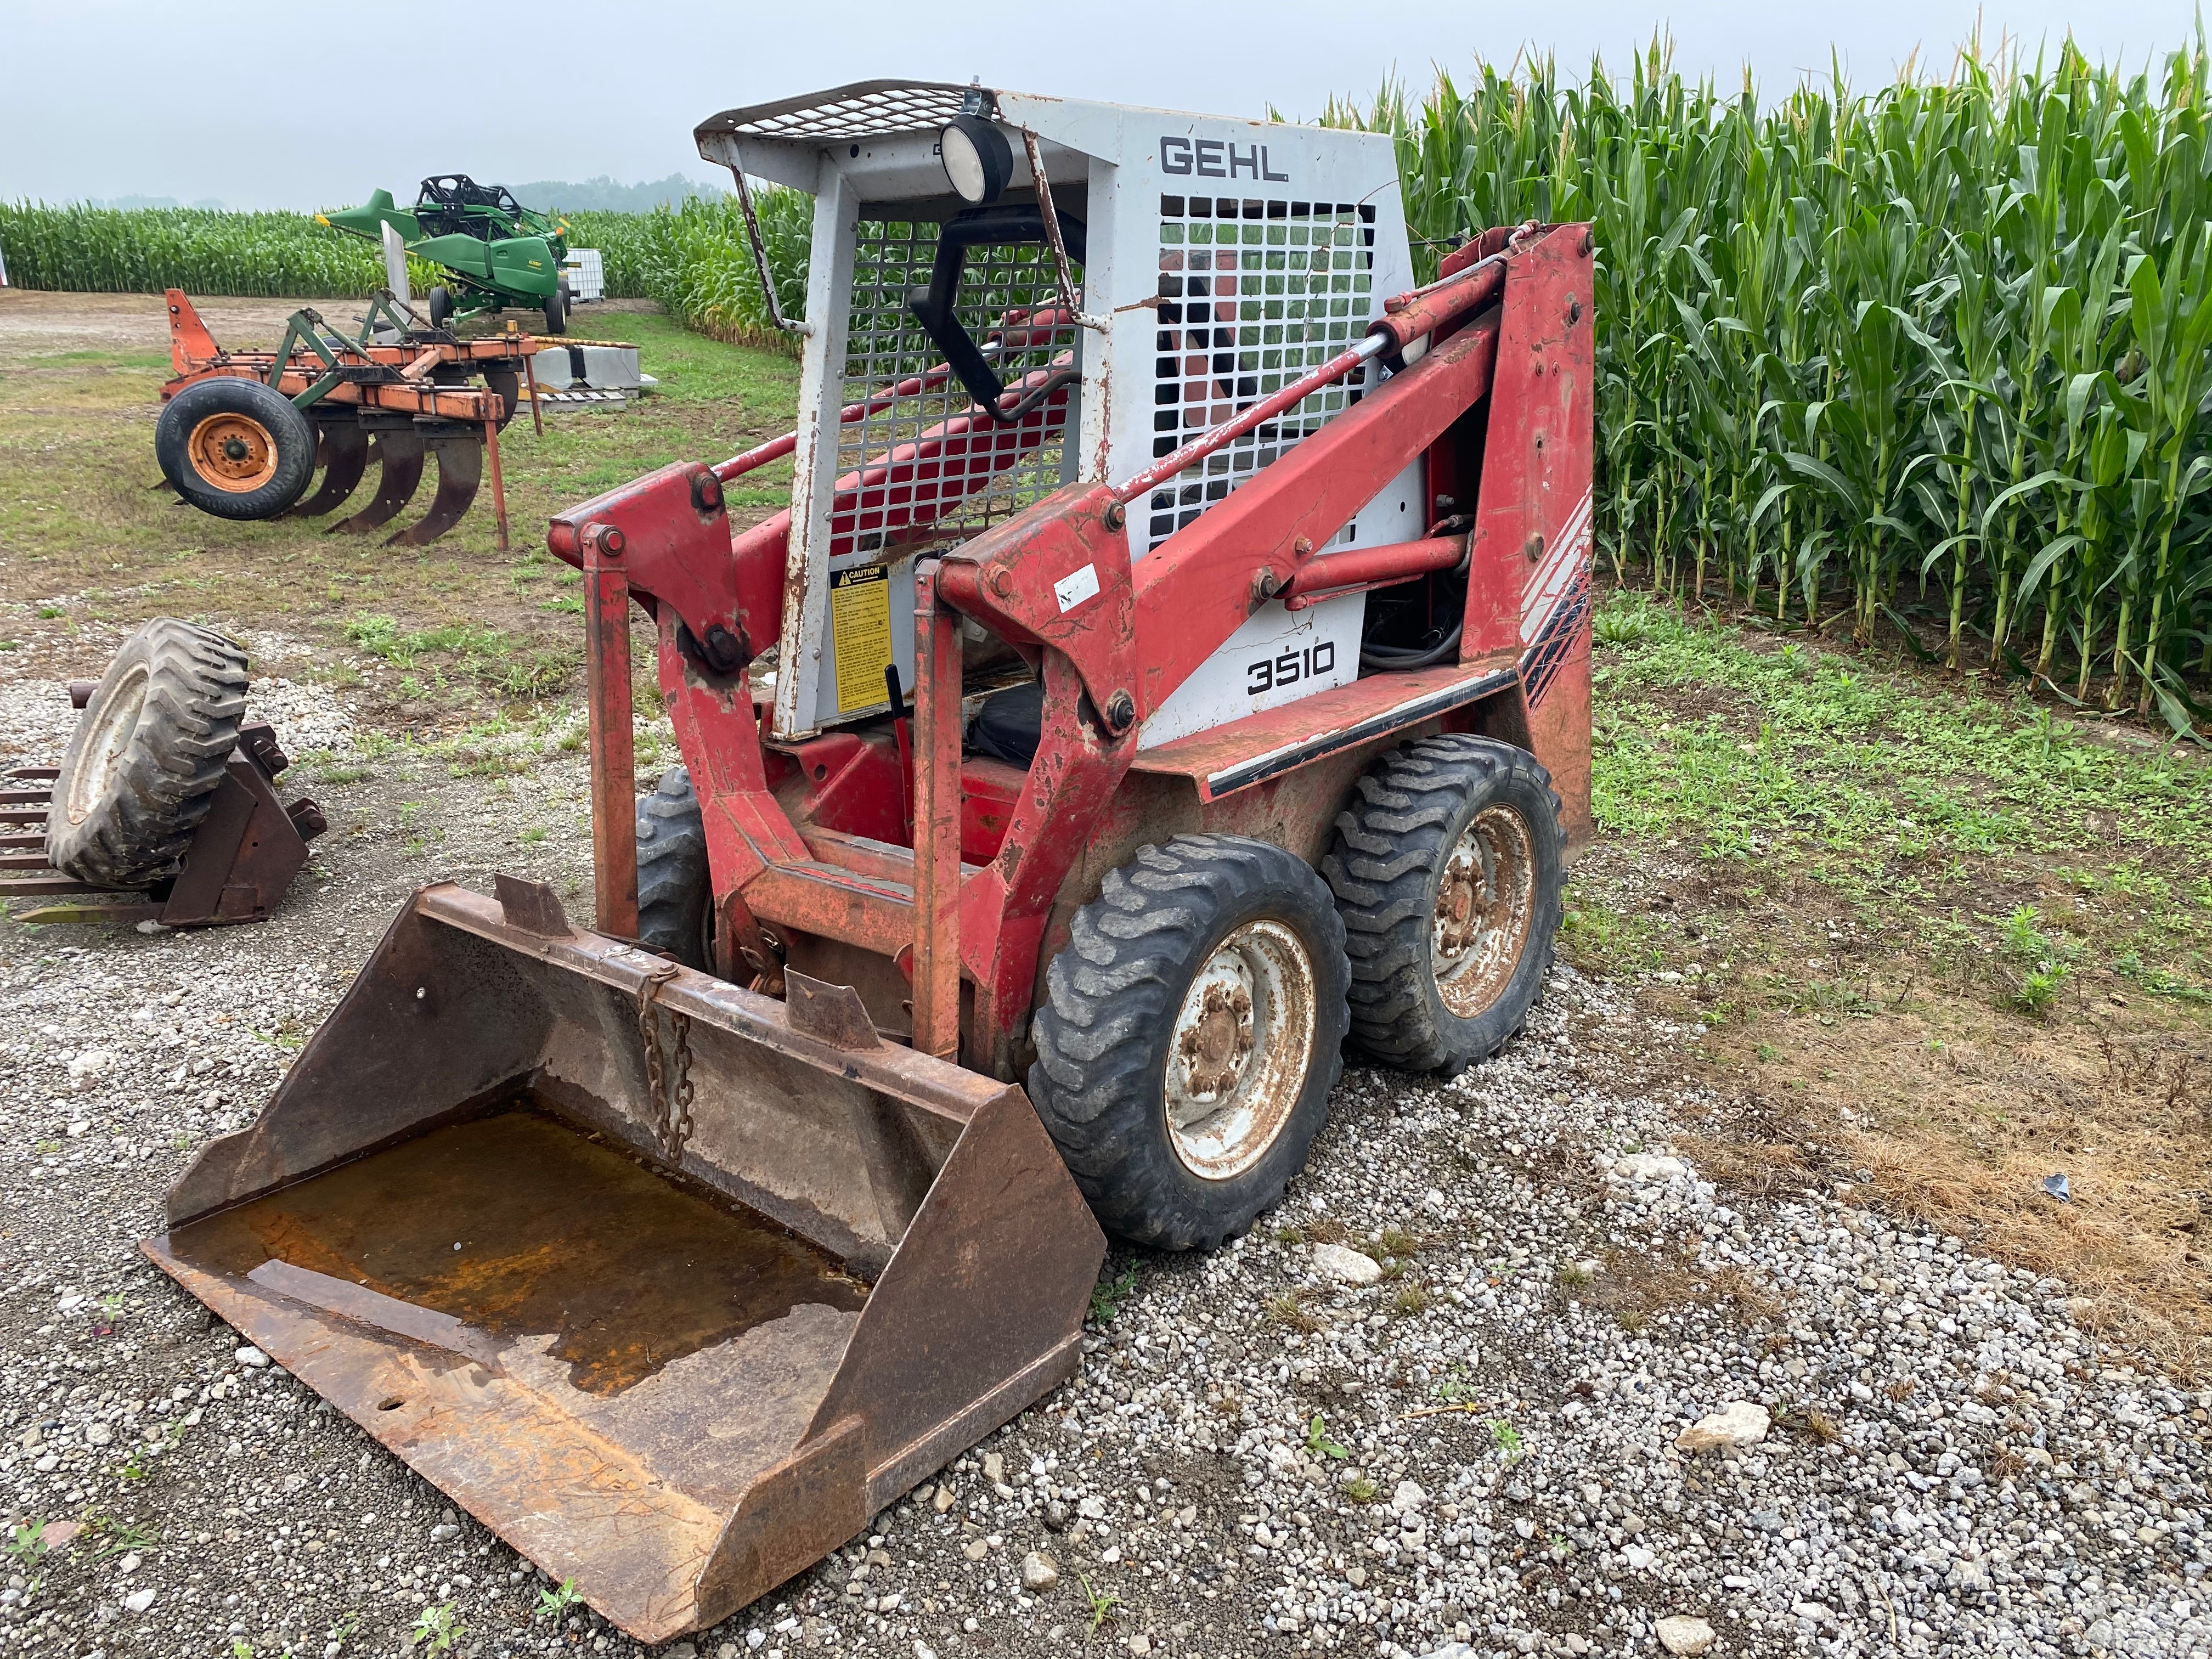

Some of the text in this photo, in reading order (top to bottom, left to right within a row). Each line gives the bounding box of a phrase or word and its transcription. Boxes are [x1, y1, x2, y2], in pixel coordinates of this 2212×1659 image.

[1160, 136, 1289, 182] GEHL
[849, 567, 880, 579] CAUTION
[1248, 641, 1334, 695] 3510
